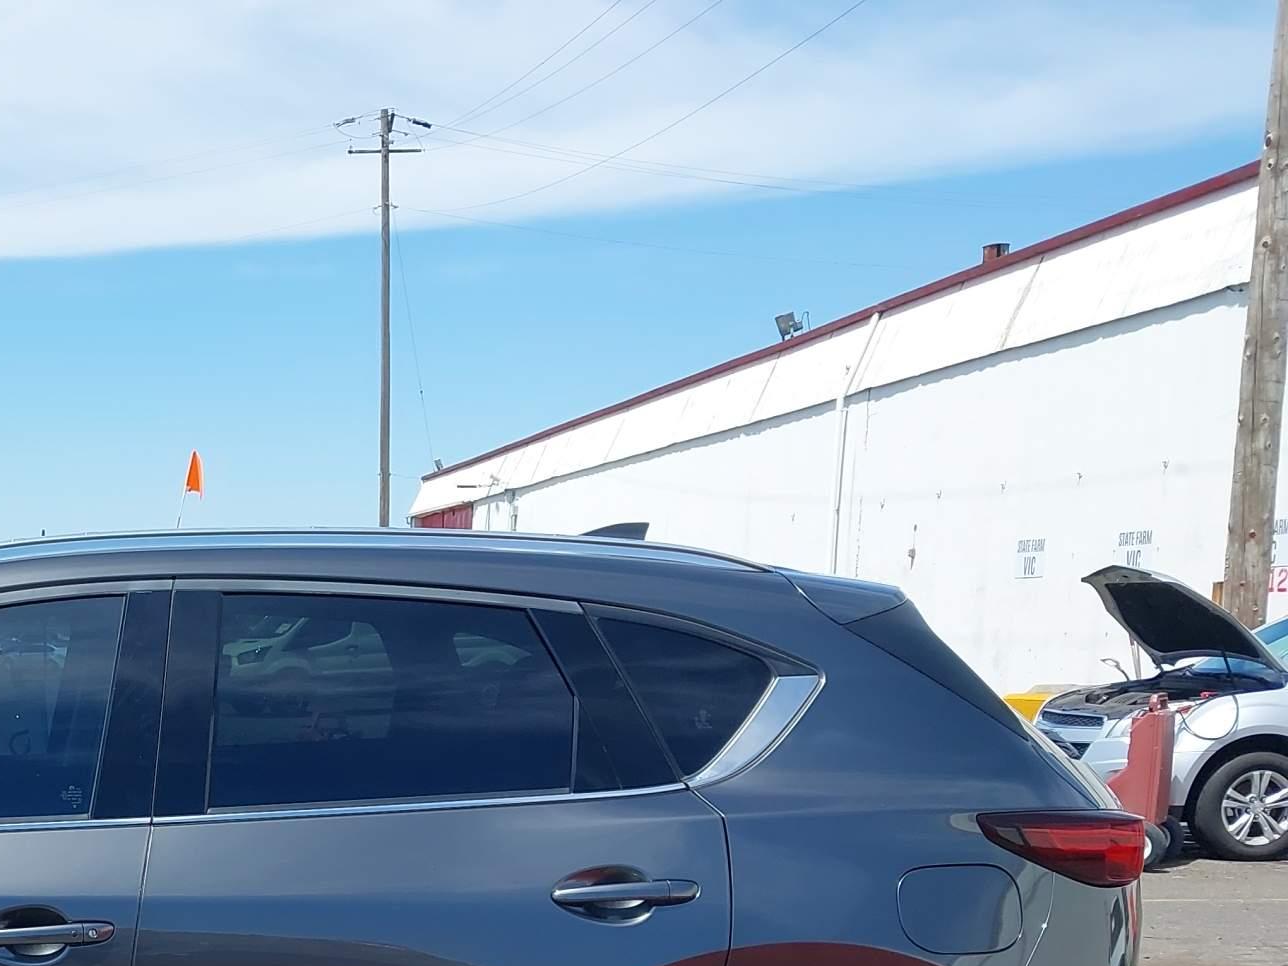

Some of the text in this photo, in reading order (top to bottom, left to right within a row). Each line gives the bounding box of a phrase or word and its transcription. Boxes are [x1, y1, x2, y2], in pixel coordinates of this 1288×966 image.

[1118, 529, 1153, 547] STATE FARM
[1023, 555, 1037, 576] VIC
[1126, 549, 1142, 569] VIC
